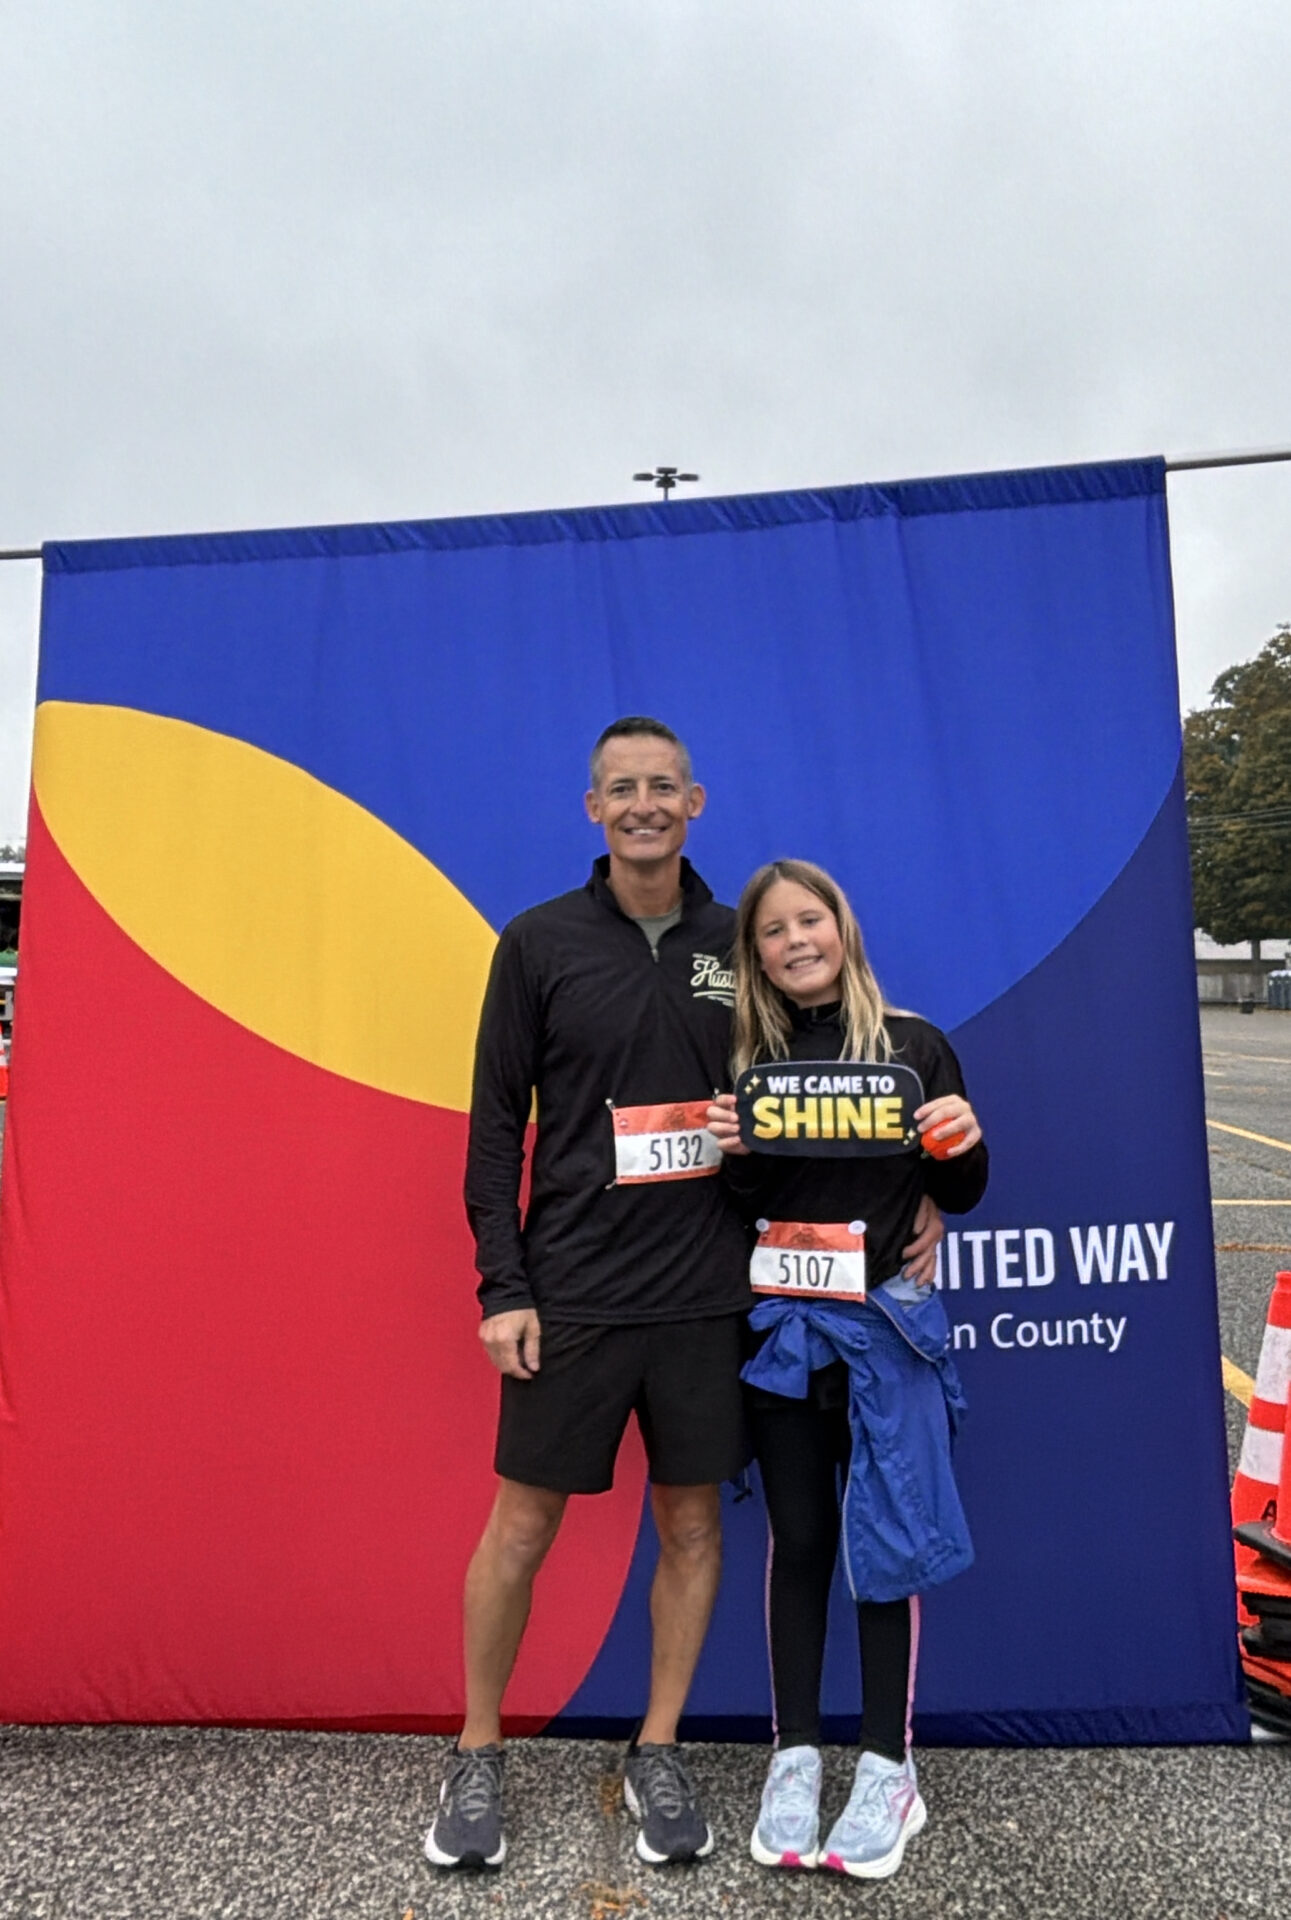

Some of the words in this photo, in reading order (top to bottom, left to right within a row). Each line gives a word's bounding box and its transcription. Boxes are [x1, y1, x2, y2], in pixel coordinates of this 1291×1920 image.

[690, 959, 736, 989] Hust
[766, 1075, 801, 1094] WE
[804, 1075, 863, 1094] CAME
[867, 1075, 895, 1094] TO
[752, 1096, 904, 1140] SHINE
[649, 1134, 704, 1172] 5132
[779, 1253, 835, 1288] 5107
[1069, 1221, 1175, 1285] WAY
[944, 1323, 977, 1350] n
[991, 1313, 1128, 1353] County
